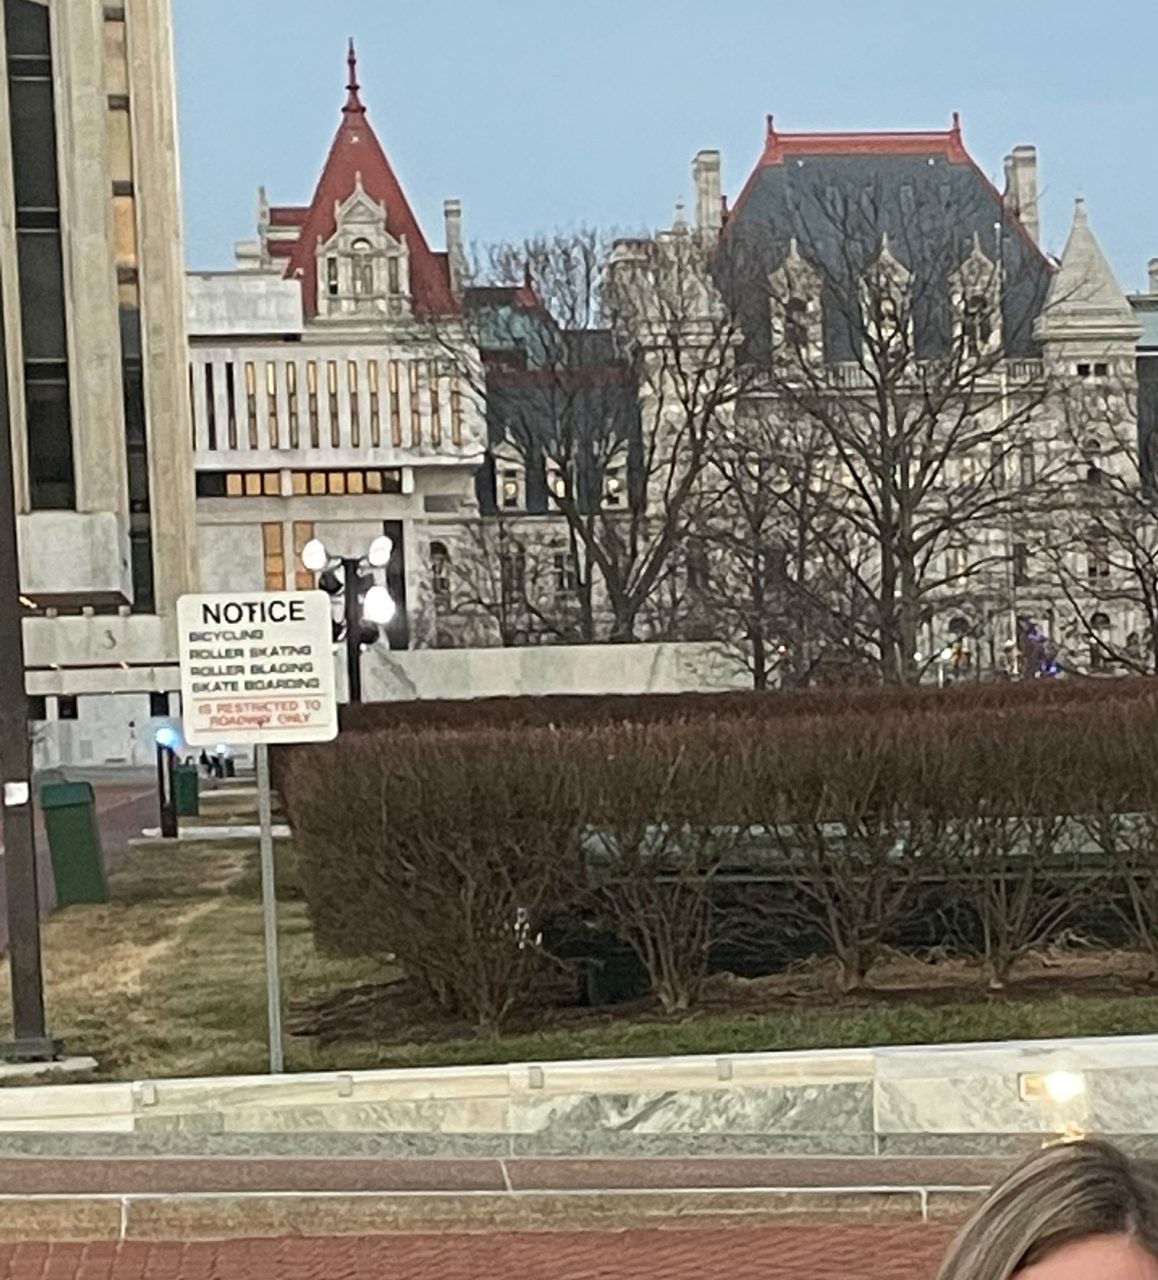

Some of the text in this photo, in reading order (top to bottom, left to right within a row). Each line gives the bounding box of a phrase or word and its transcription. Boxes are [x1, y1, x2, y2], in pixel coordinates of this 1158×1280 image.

[202, 600, 305, 624] NOTICE
[188, 629, 264, 642] BICYCLING
[189, 645, 312, 660] ROLLER SKATING
[190, 662, 313, 677] ROLLER BLADING
[192, 678, 320, 693] SKATE BOARDING
[217, 700, 298, 714] RESTRICTED
[305, 699, 321, 711] TO
